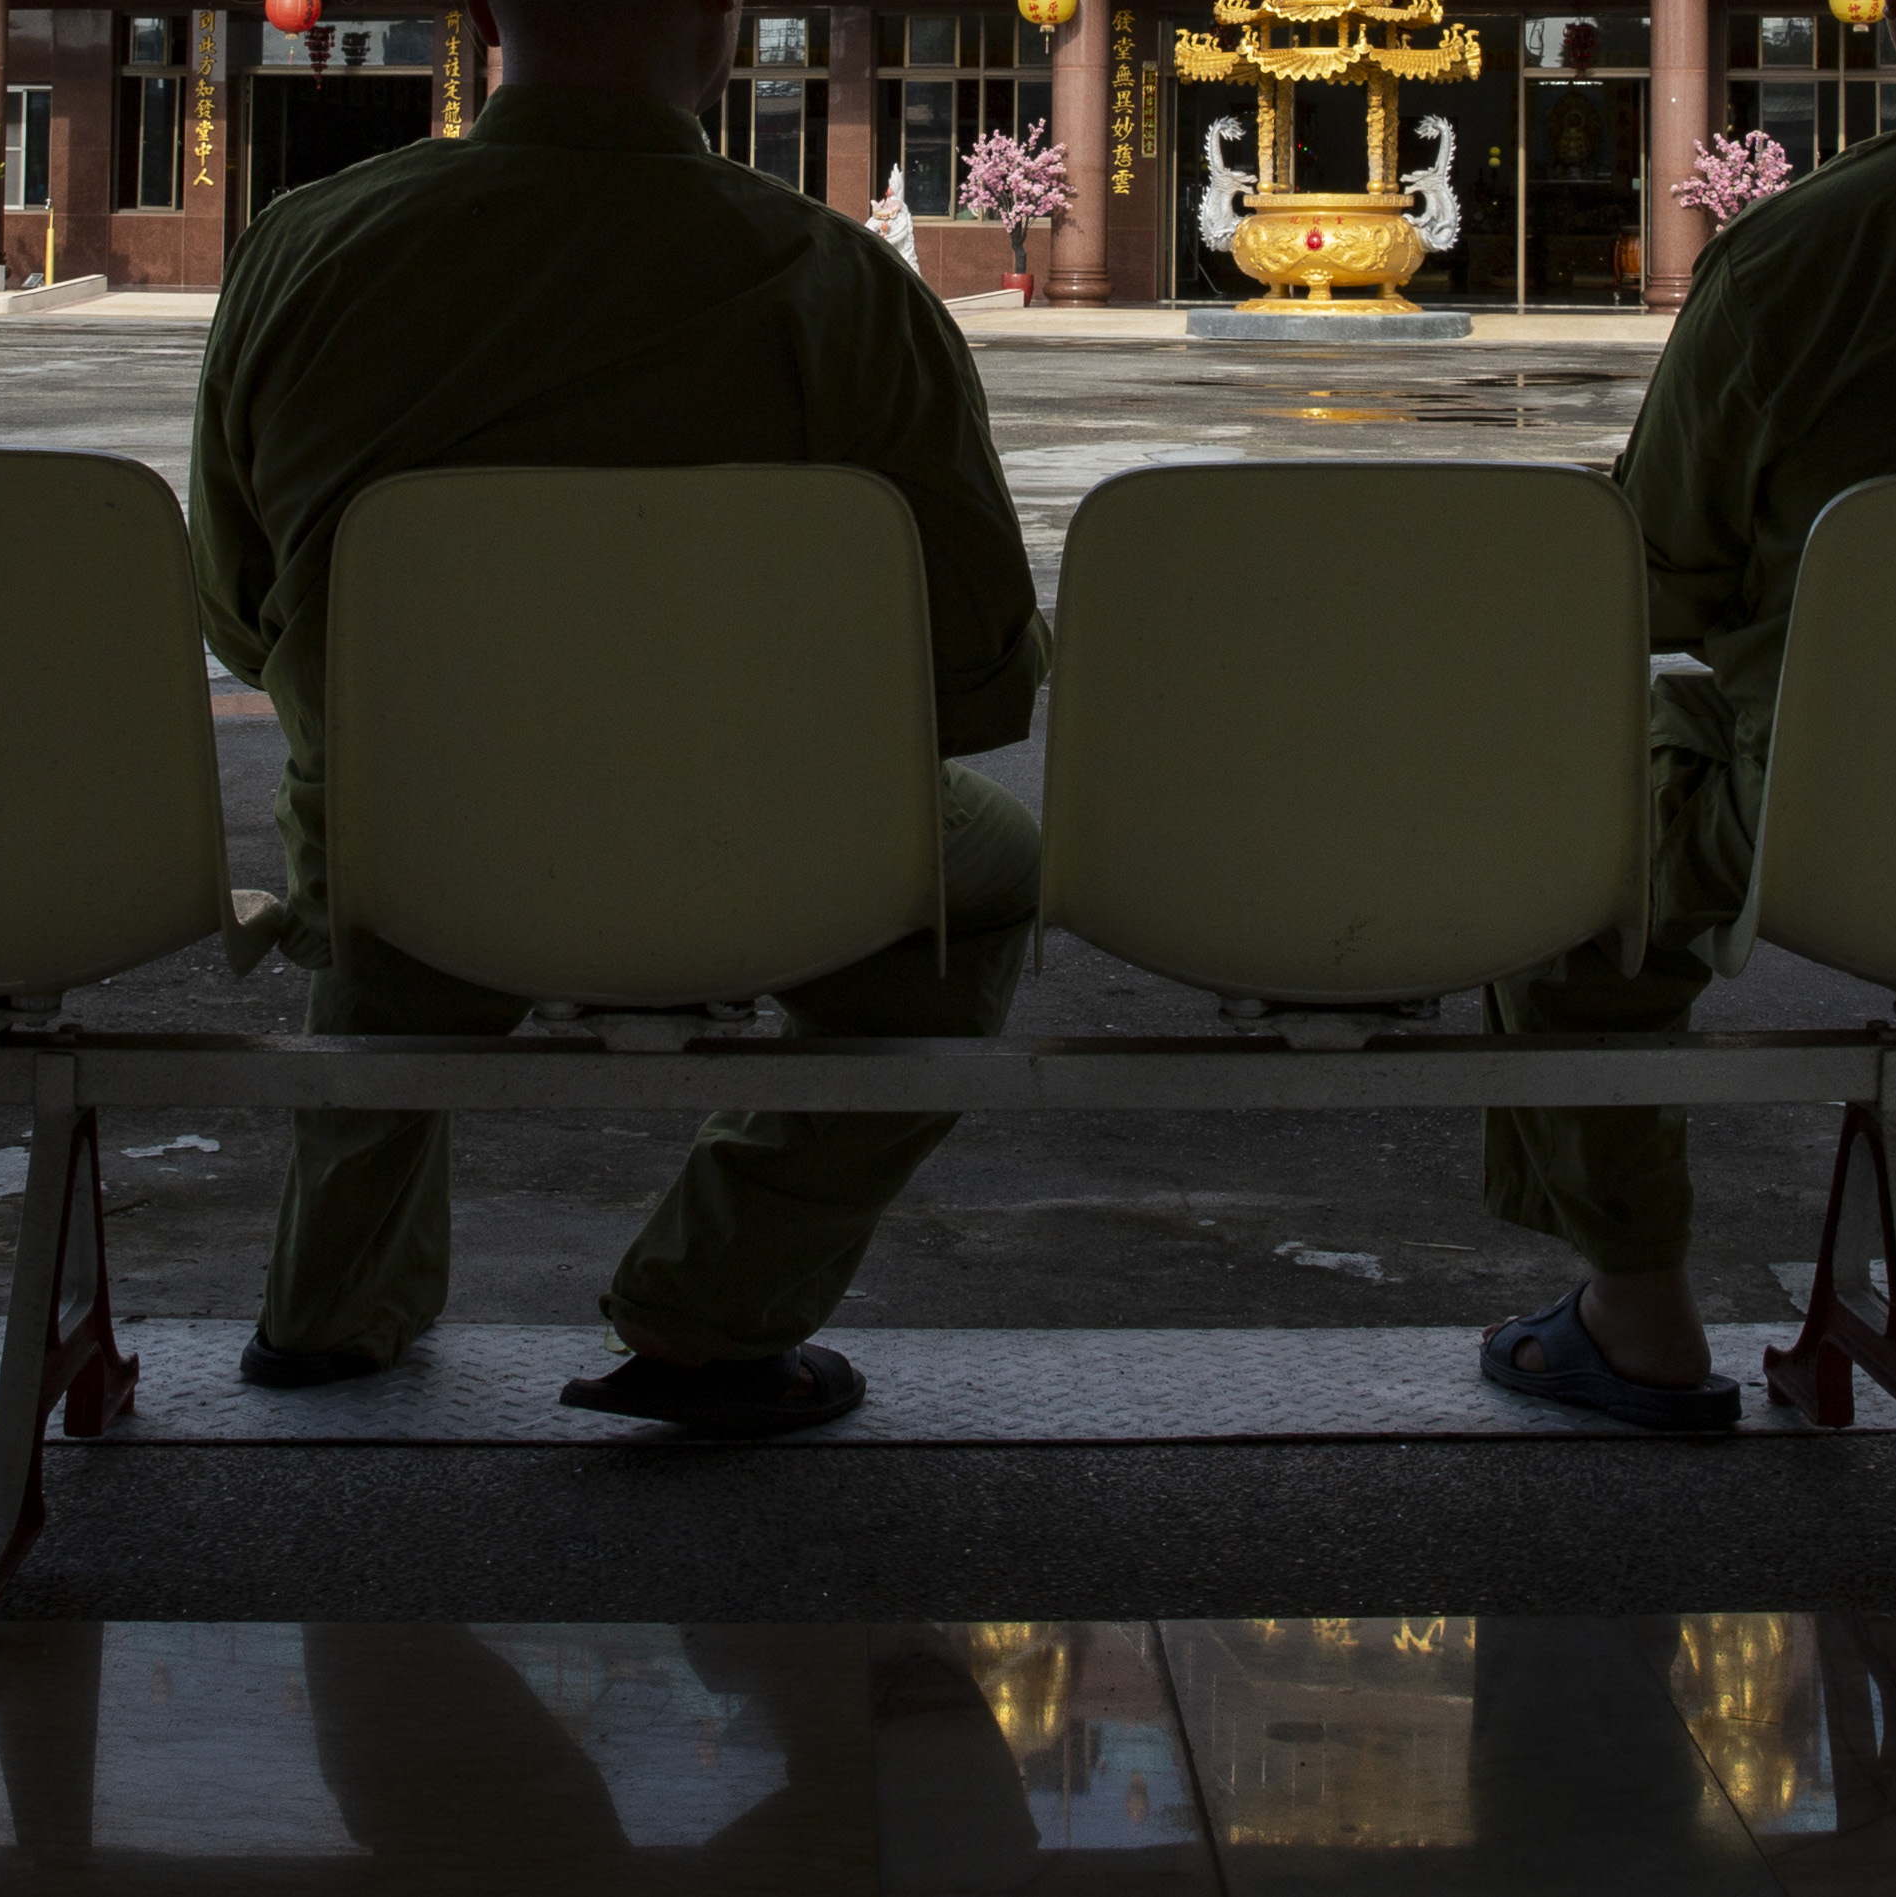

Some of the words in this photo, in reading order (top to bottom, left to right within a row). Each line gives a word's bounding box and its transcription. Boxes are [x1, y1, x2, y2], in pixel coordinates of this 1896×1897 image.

[193, 11, 217, 186] 到此方知發堂中人
